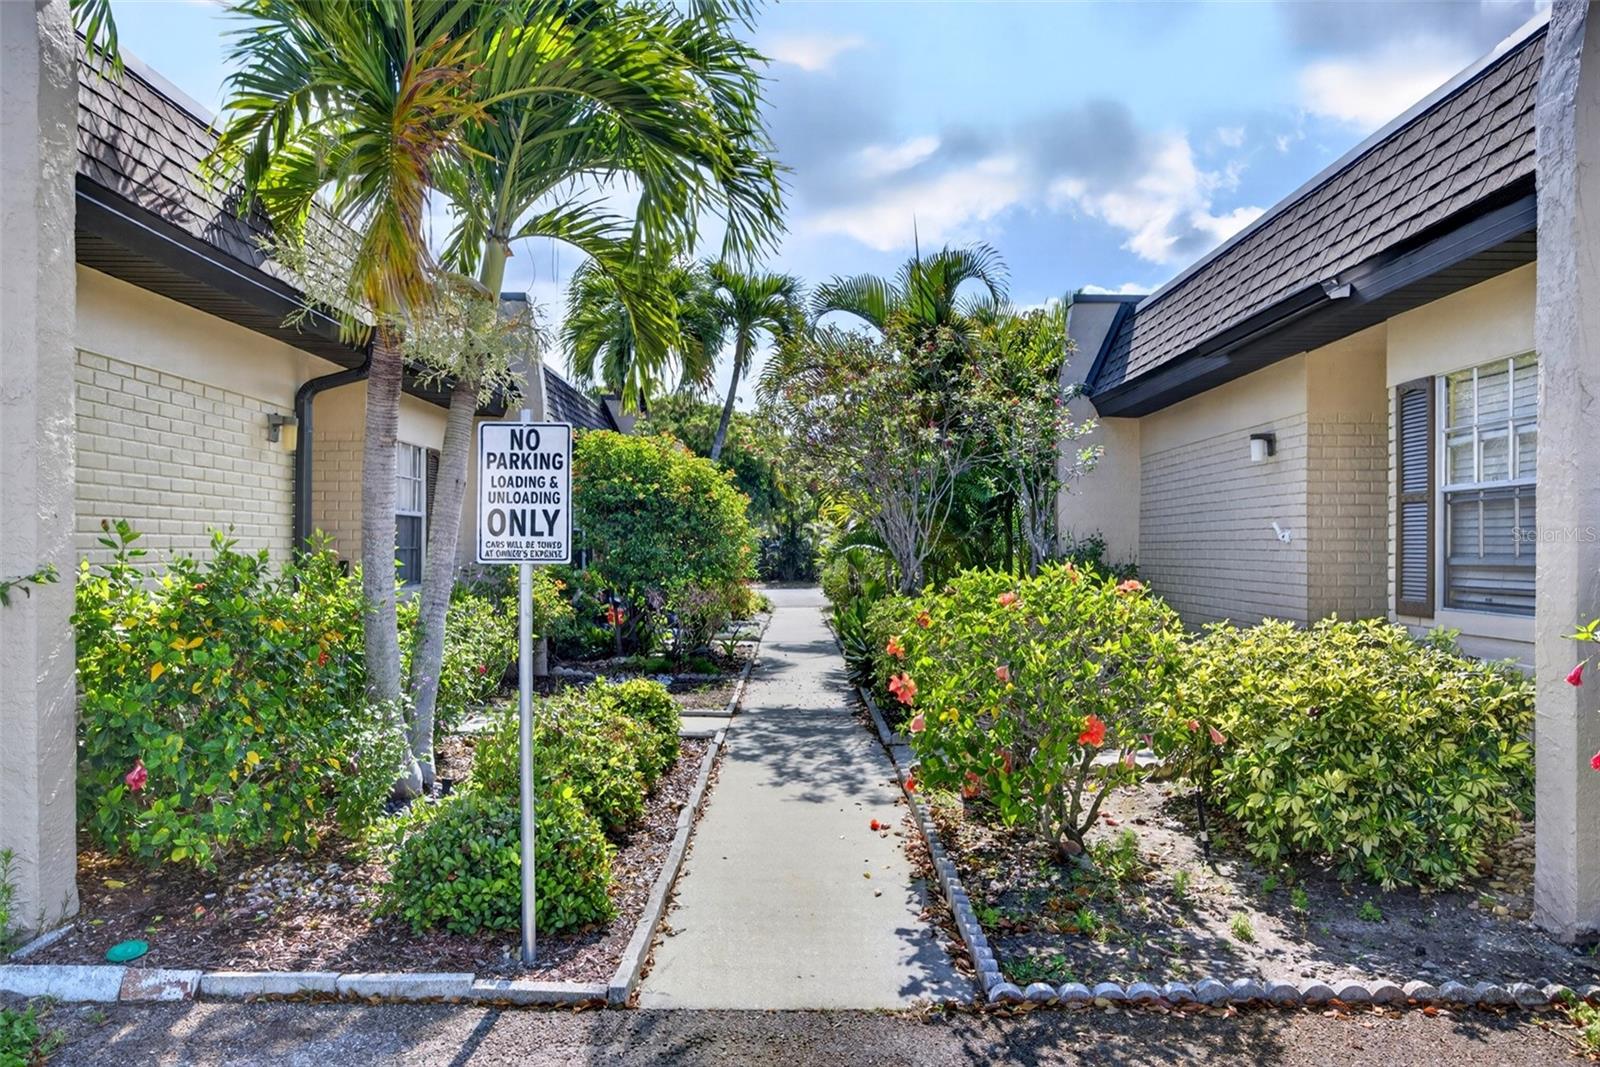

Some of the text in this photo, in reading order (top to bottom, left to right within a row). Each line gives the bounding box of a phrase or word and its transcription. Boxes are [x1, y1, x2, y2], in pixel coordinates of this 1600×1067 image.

[510, 428, 540, 451] NO
[486, 452, 563, 470] PARKING
[491, 475, 558, 488] LOADING &
[488, 491, 560, 504] UNLOADING
[487, 508, 560, 537] ONLY
[506, 541, 523, 549] WILL
[525, 541, 535, 549] BE
[537, 541, 562, 549] TOWED
[529, 550, 562, 558] EXPENSE
